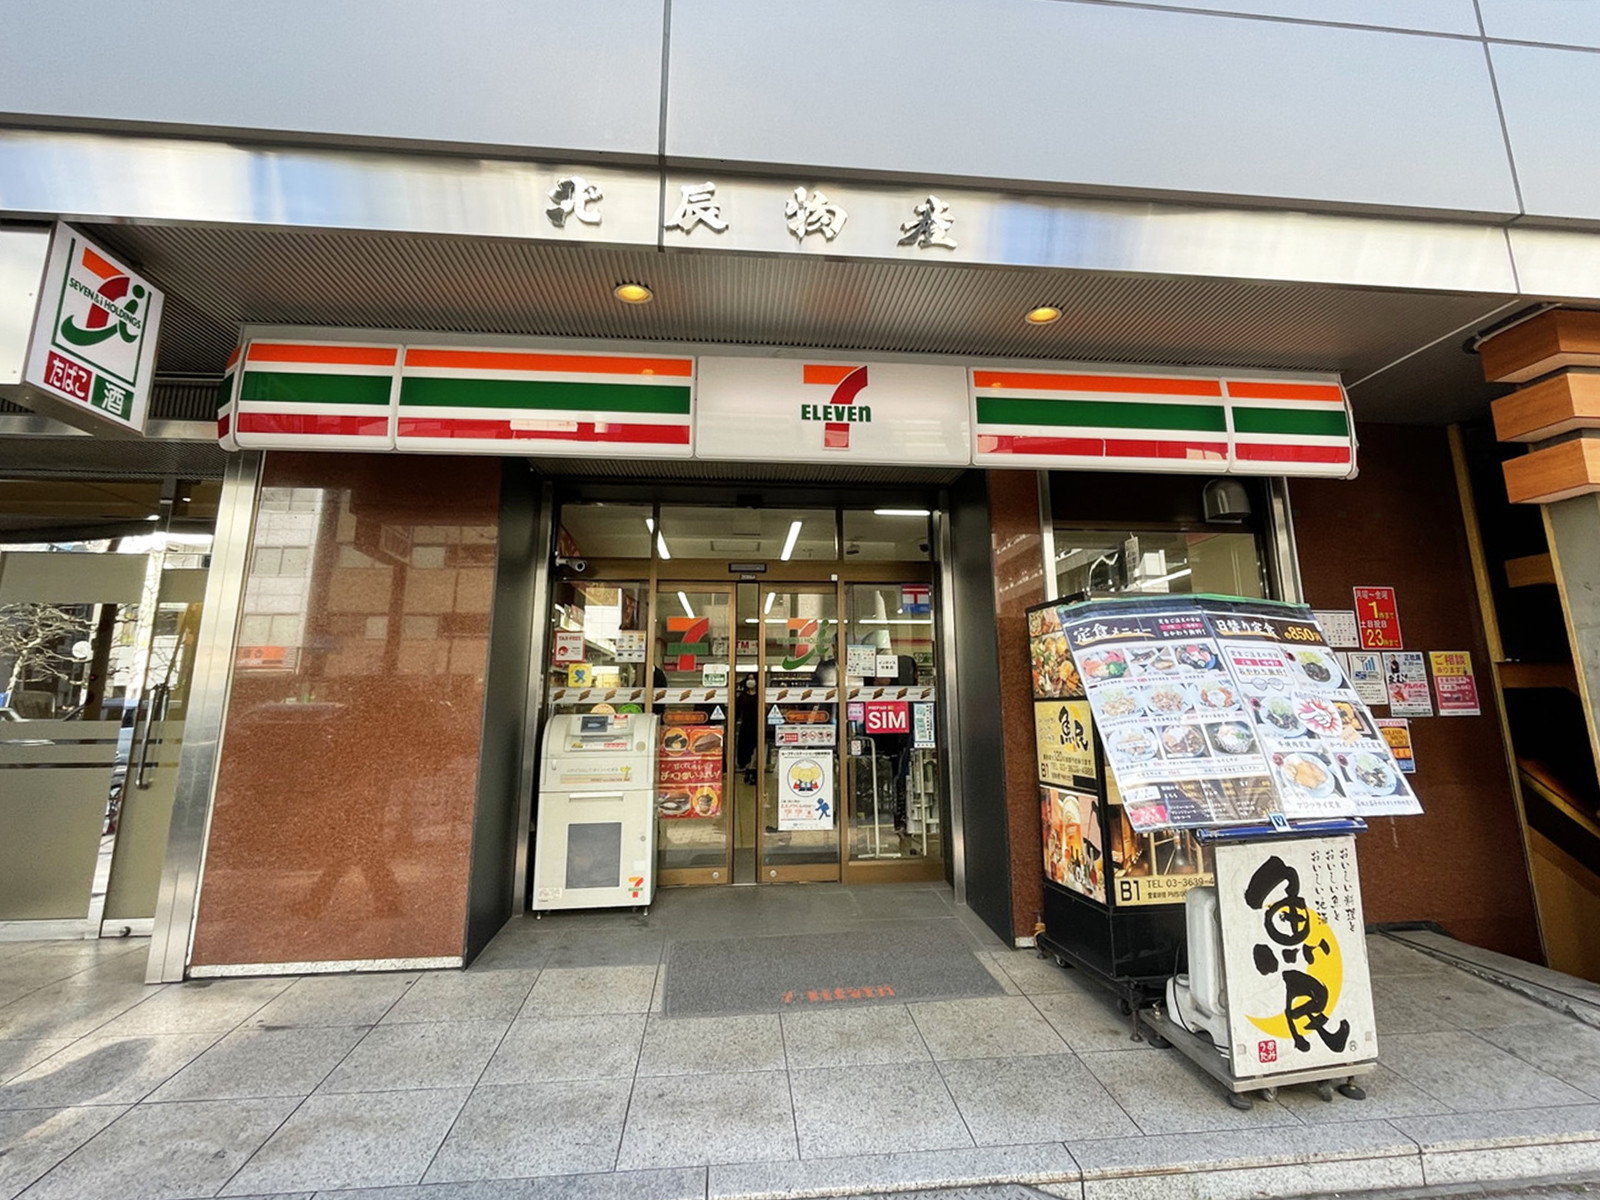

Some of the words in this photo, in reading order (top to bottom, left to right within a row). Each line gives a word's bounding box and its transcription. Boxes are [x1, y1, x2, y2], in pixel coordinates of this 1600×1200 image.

[104, 300, 142, 329] HOLDINGS
[50, 356, 89, 397] たばこ
[101, 381, 126, 415] 酒
[1073, 622, 1152, 644] 定食メニュー
[1216, 619, 1276, 635] 日替り定食
[1434, 654, 1466, 666] ご相談
[868, 711, 906, 729] SIM
[1120, 880, 1140, 902] B1
[1147, 879, 1164, 889] TEL
[1245, 856, 1350, 1053] 魚民
